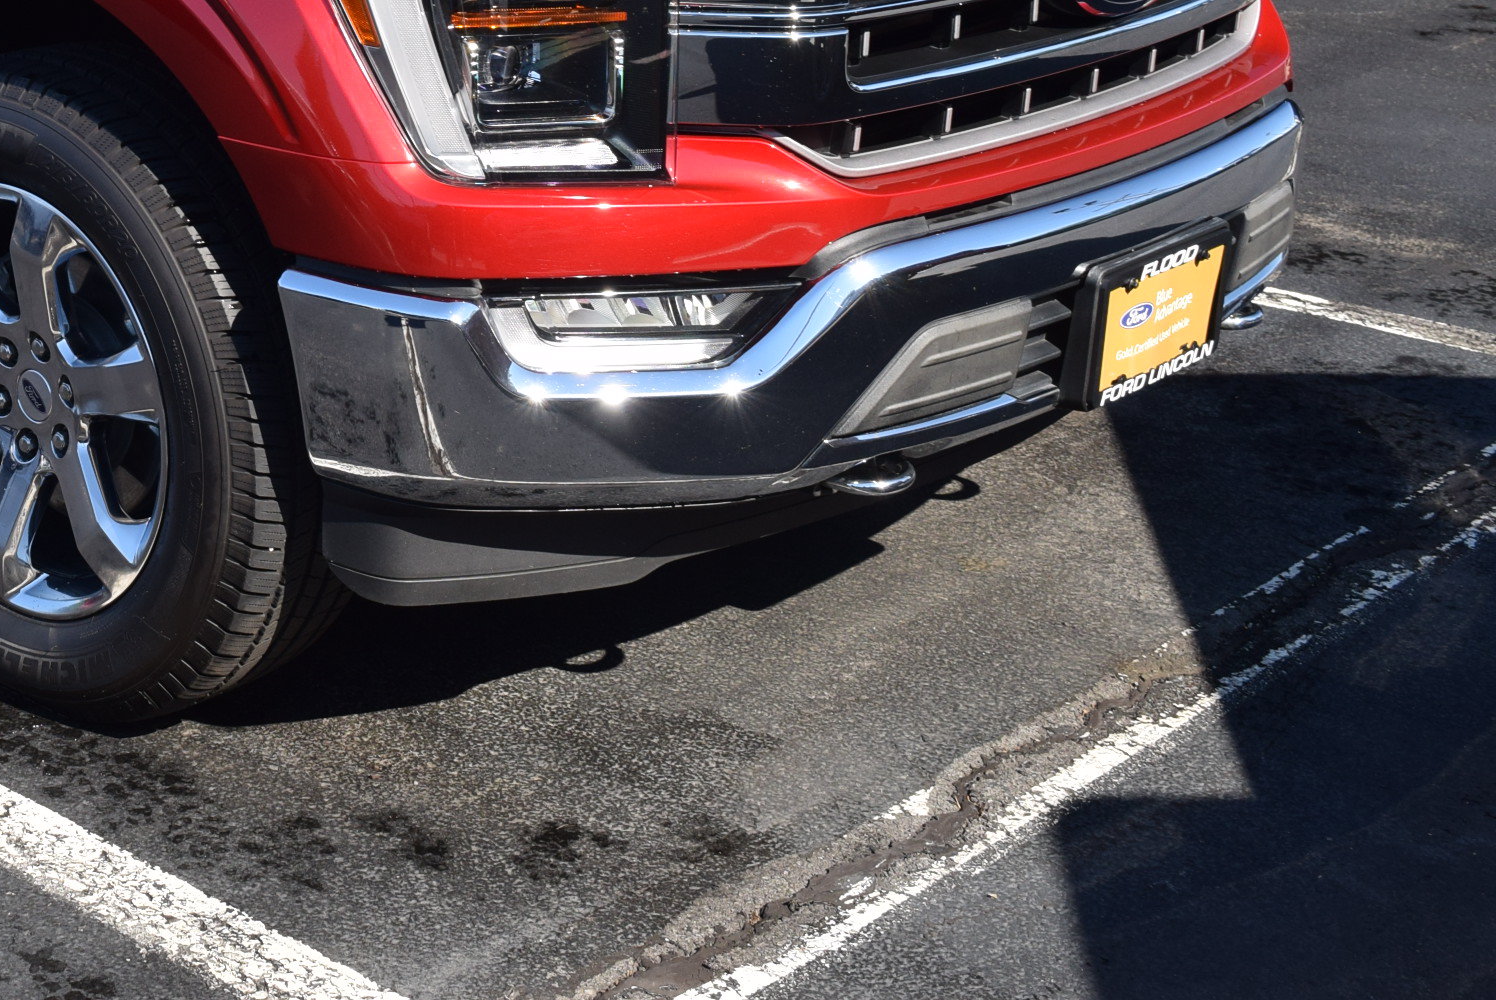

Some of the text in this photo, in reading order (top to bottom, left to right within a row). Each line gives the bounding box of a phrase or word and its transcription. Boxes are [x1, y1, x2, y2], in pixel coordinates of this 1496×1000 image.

[1140, 244, 1200, 282] FLOOD
[1154, 292, 1193, 322] Advantage
[1156, 287, 1173, 306] Blue
[1126, 307, 1149, 326] Ford
[1116, 317, 1191, 361] Gold Certified Used Vehicle
[1100, 340, 1214, 407] FORD LINCOLN
